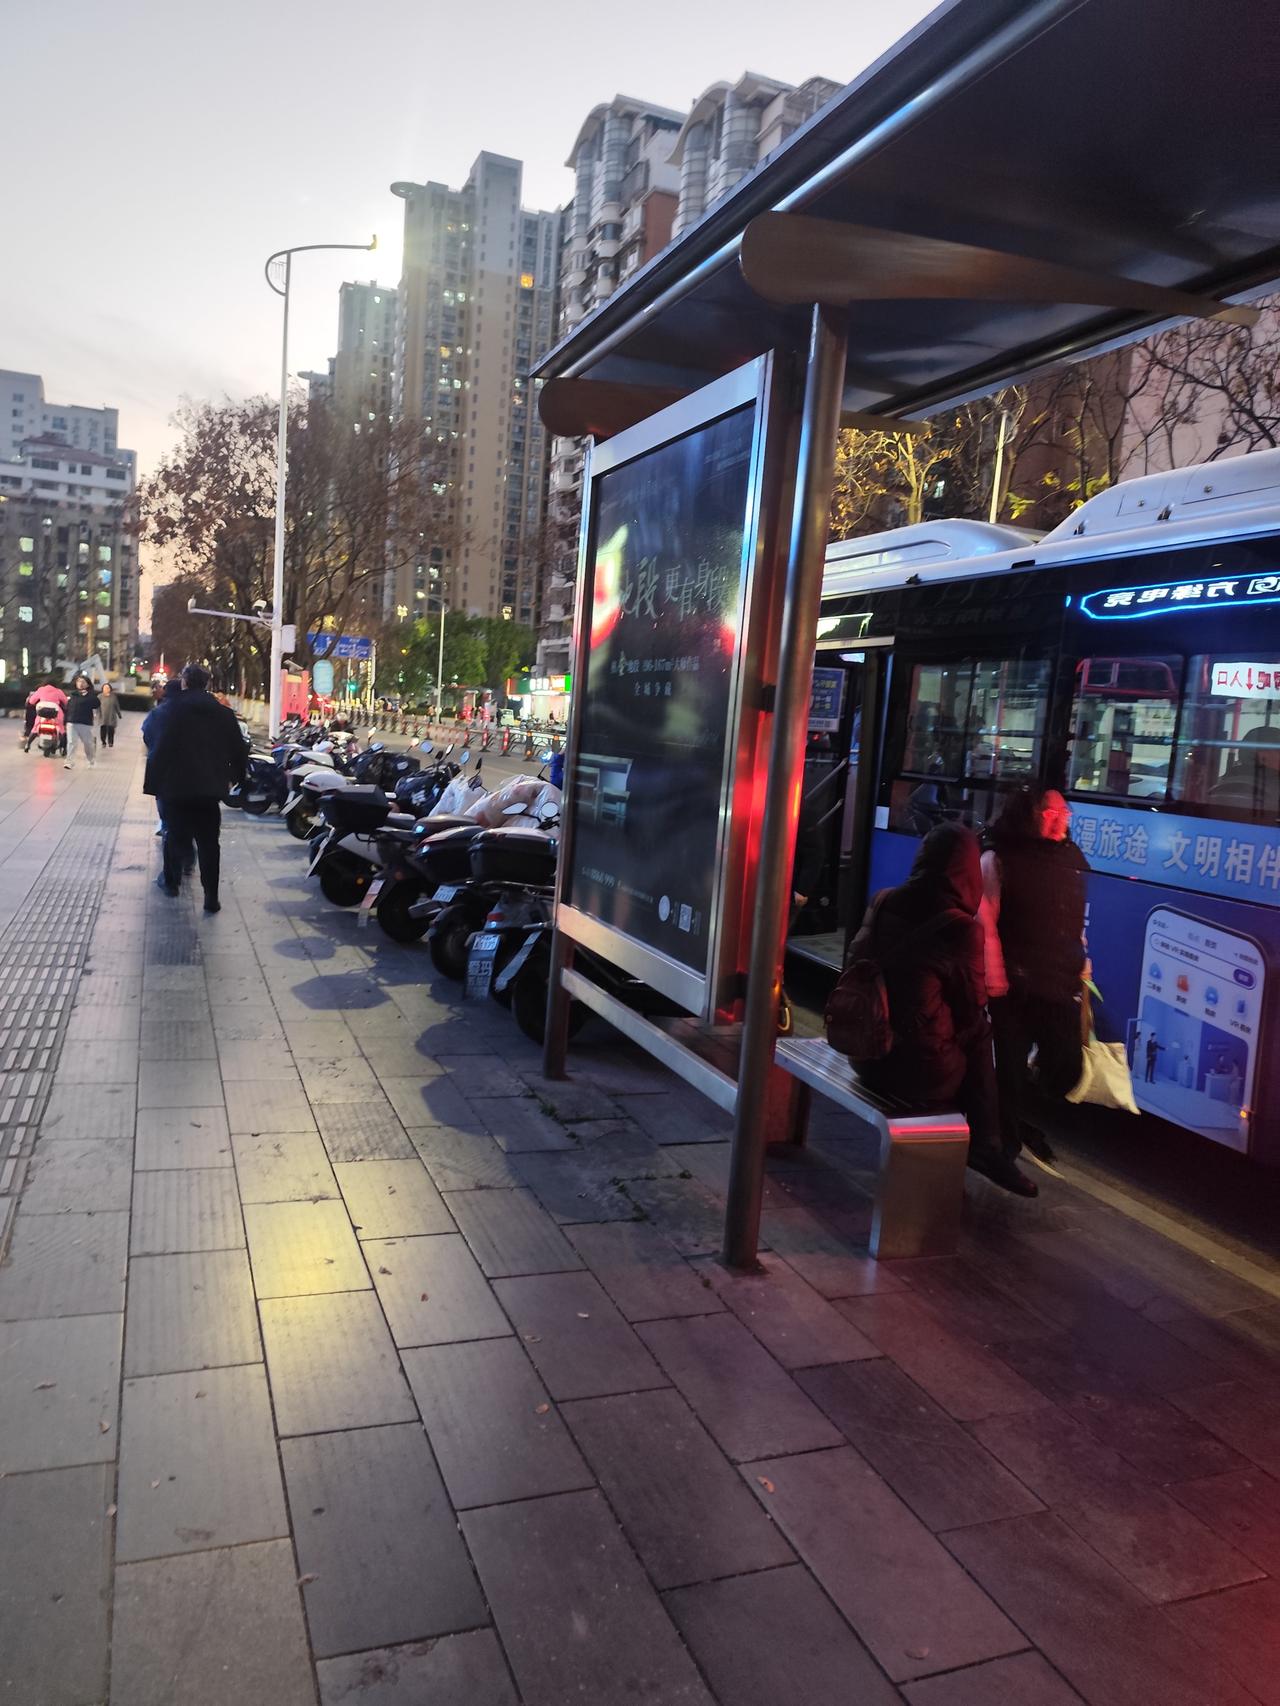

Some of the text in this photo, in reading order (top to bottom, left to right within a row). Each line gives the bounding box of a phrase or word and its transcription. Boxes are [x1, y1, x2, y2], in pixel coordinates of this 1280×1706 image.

[1067, 816, 1280, 890] 漫旅途 文明相伴
